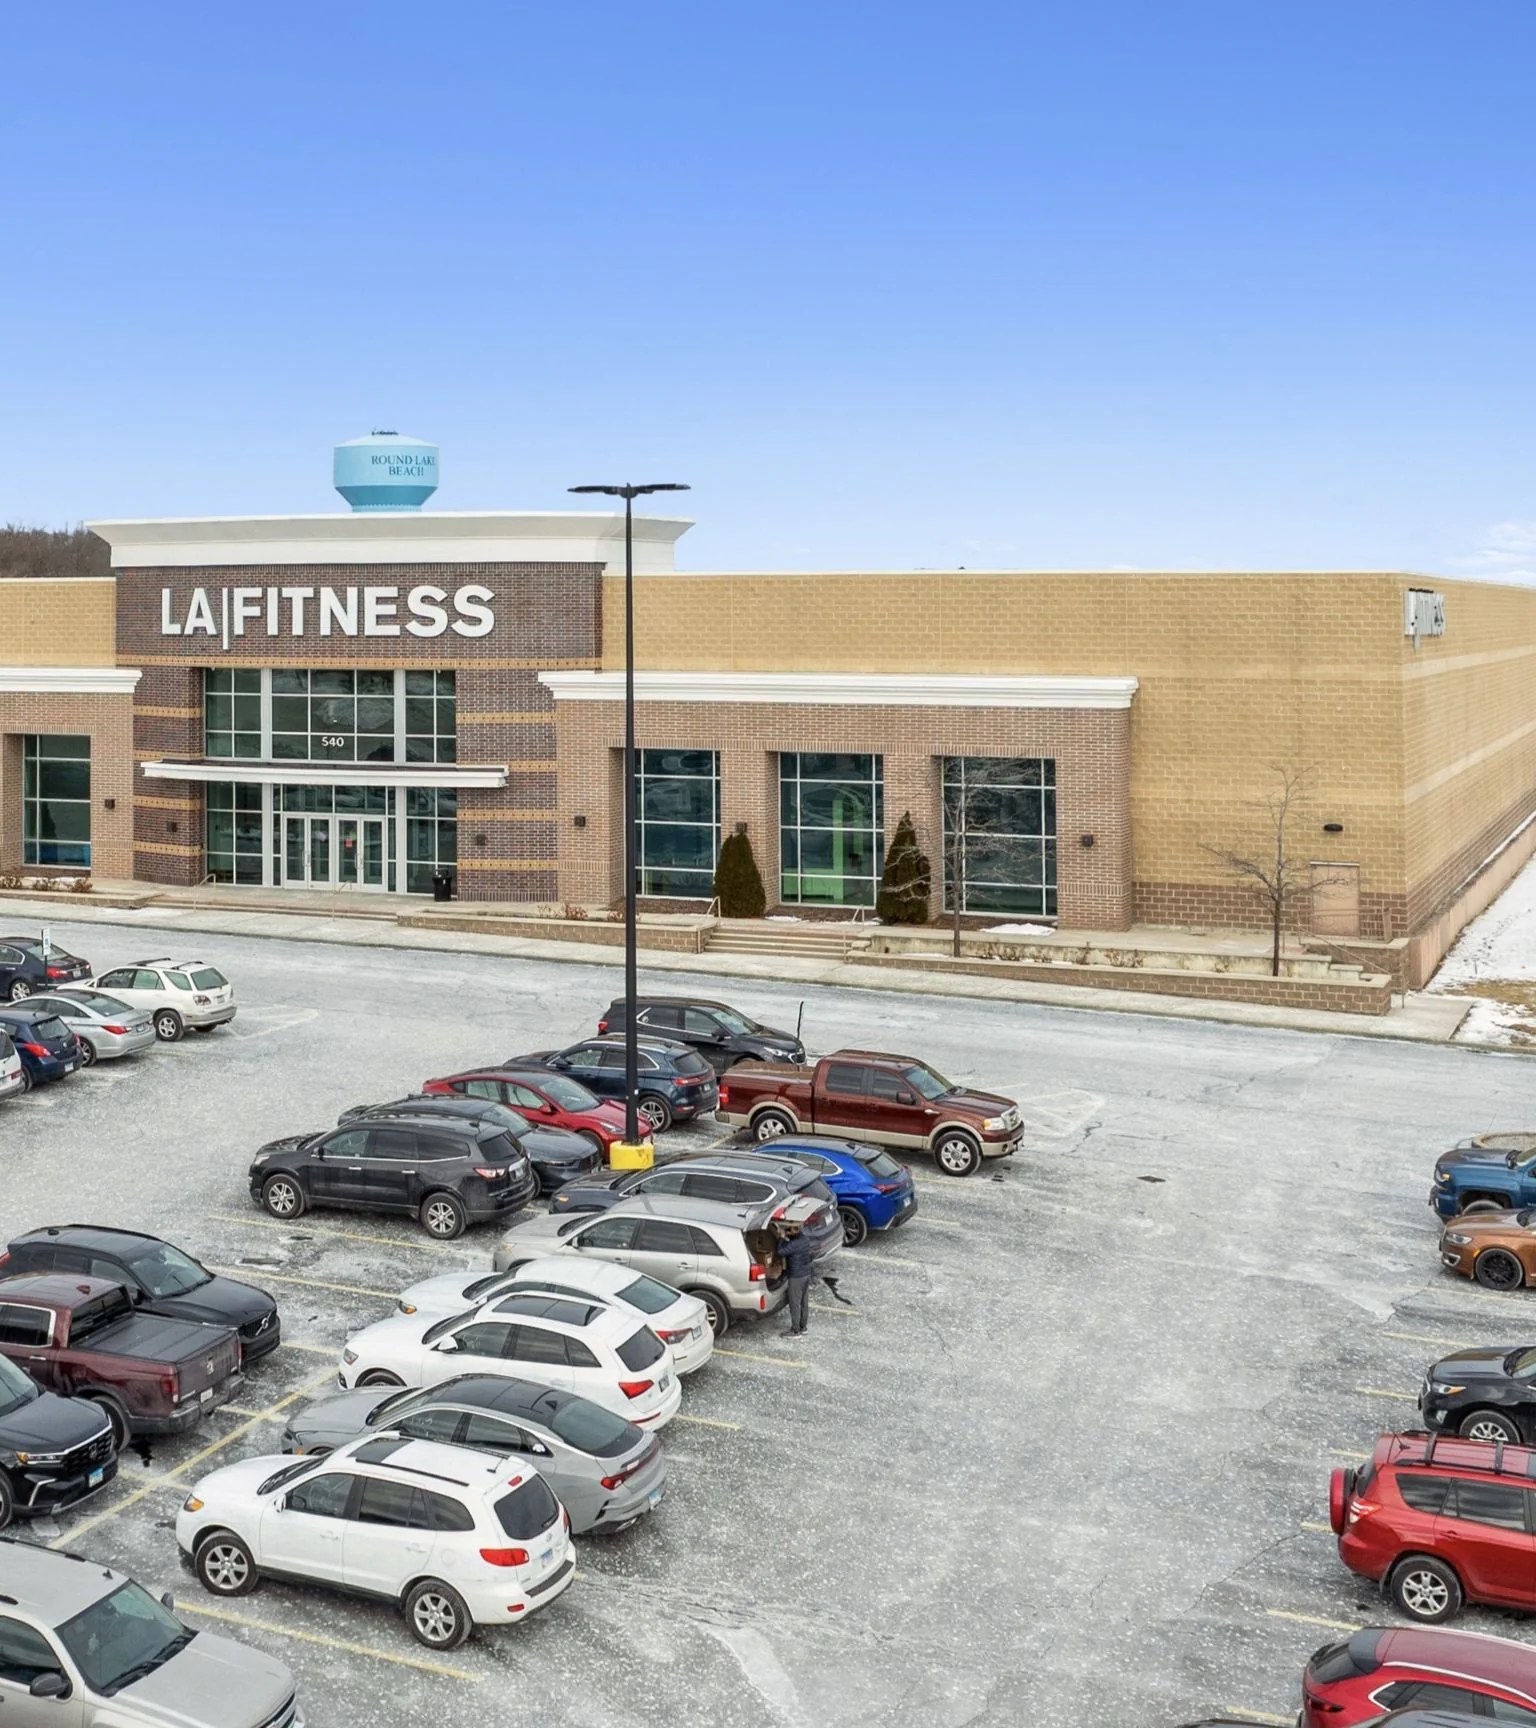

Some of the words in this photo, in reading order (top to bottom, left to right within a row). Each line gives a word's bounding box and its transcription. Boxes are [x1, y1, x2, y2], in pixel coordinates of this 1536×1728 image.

[371, 455, 413, 465] ROUND
[389, 466, 424, 477] BEACH
[321, 736, 344, 747] 540
